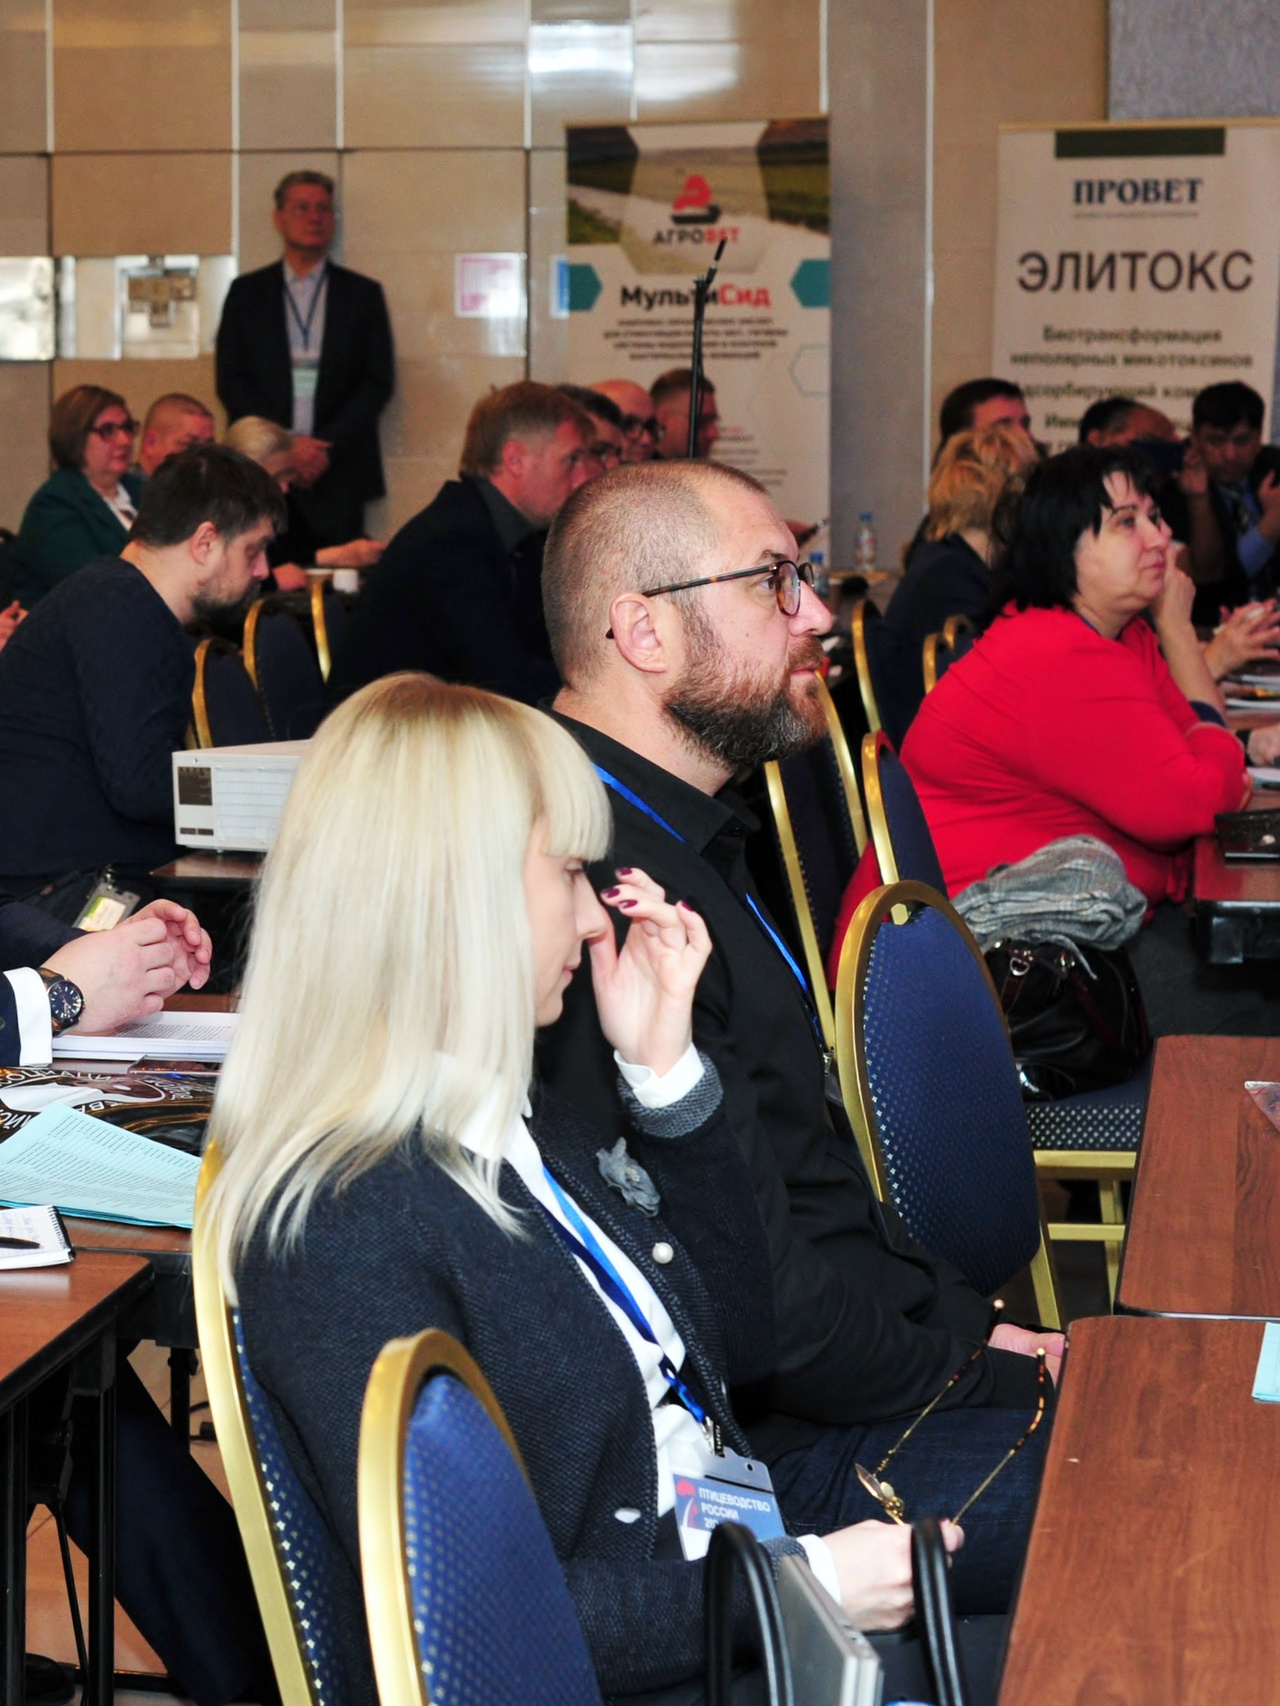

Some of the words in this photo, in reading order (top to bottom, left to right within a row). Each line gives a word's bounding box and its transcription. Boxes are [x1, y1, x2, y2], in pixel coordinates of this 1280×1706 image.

[1073, 177, 1203, 205] ПРОВЕТ
[653, 227, 739, 245] АГРОВЕТ
[1017, 250, 1254, 292] ЭЛИТОКС
[621, 283, 771, 311] МульиСид
[698, 1487, 771, 1513] ПТИЦЕВОДСТВО
[701, 1502, 739, 1520] РОССИИ
